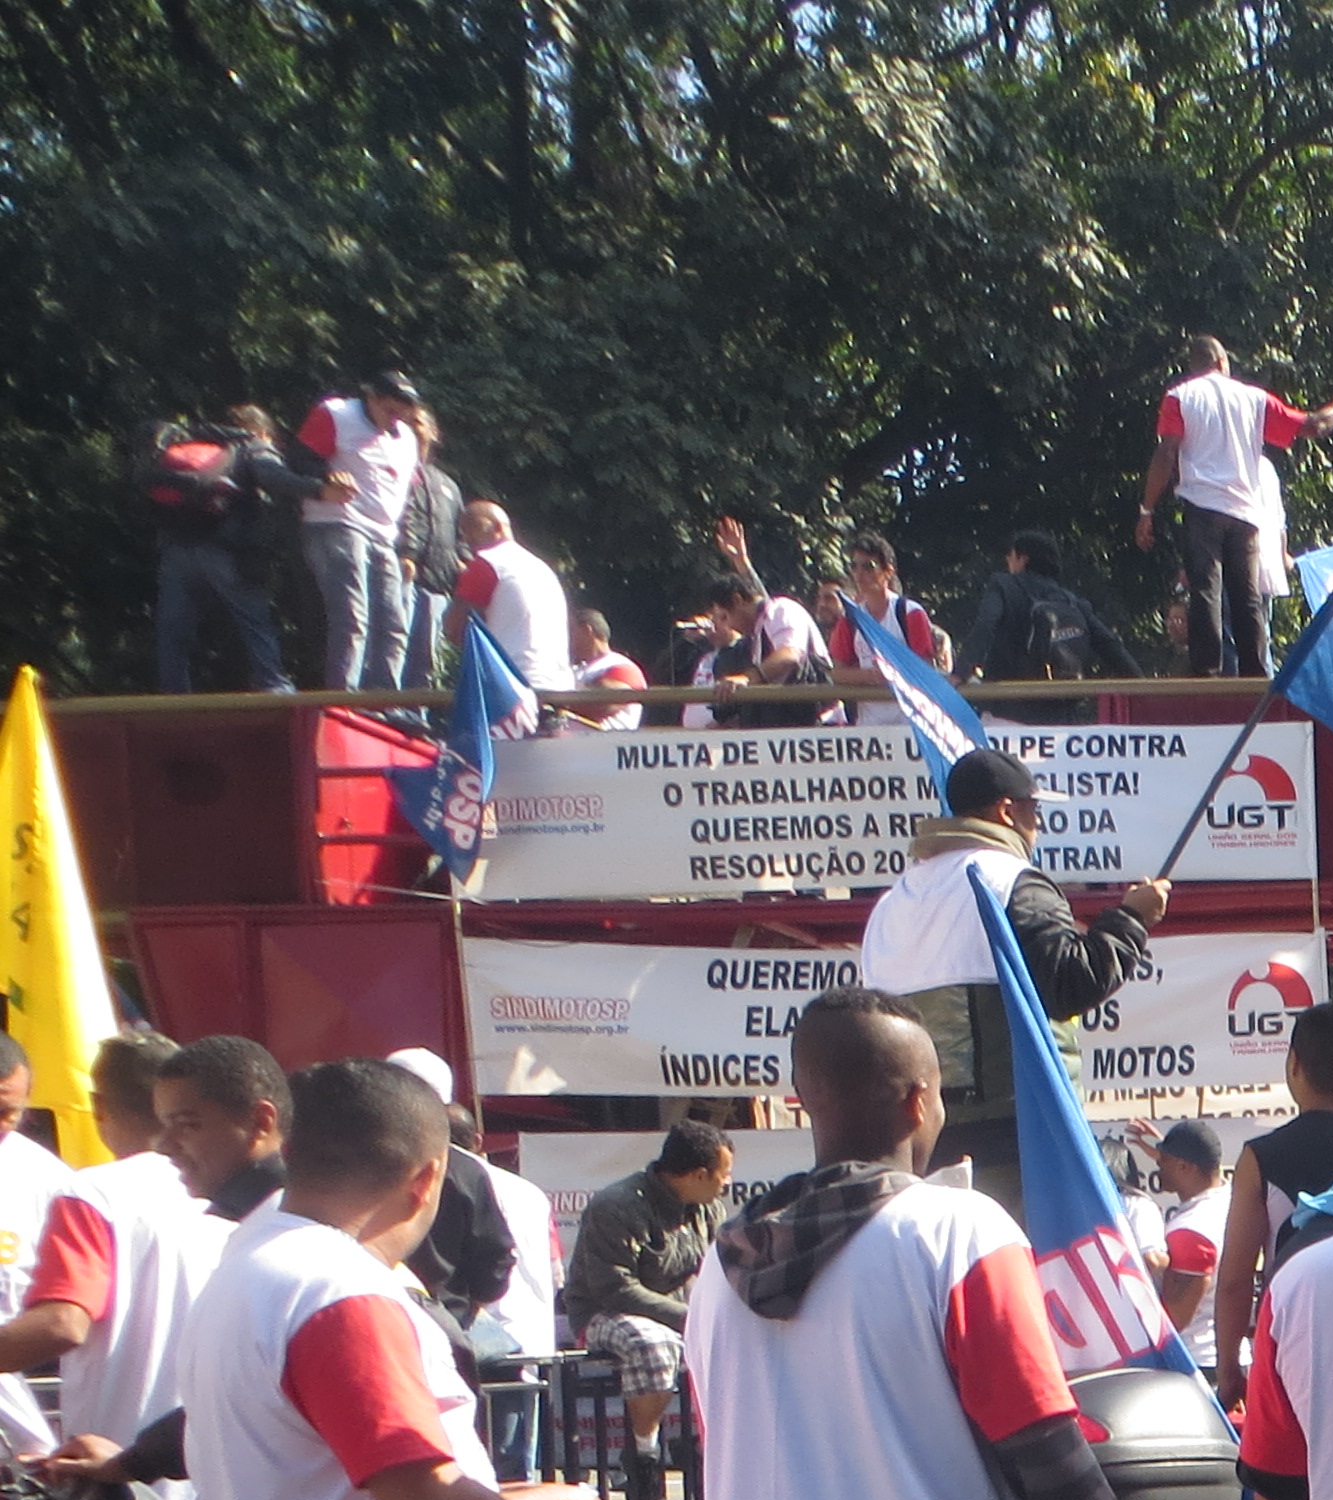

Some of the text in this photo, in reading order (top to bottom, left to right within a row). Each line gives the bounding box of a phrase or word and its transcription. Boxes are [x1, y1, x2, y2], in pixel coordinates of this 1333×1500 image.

[617, 742, 712, 770] MULTA
[722, 741, 758, 765] DE
[768, 737, 893, 765] VISEIRA:
[905, 737, 922, 761] U
[1065, 735, 1187, 758] CONTRA
[663, 782, 683, 807] O
[691, 776, 907, 806] TRABALHADOR
[691, 815, 860, 844] QUEREMOS
[863, 815, 880, 837] A
[1079, 810, 1117, 834] DA
[1206, 803, 1296, 831] UGT
[691, 849, 866, 884] RESOLUÇÃO
[707, 959, 863, 991] QUEREMO
[661, 1045, 1196, 1087] ÍNDICES MOTOS
